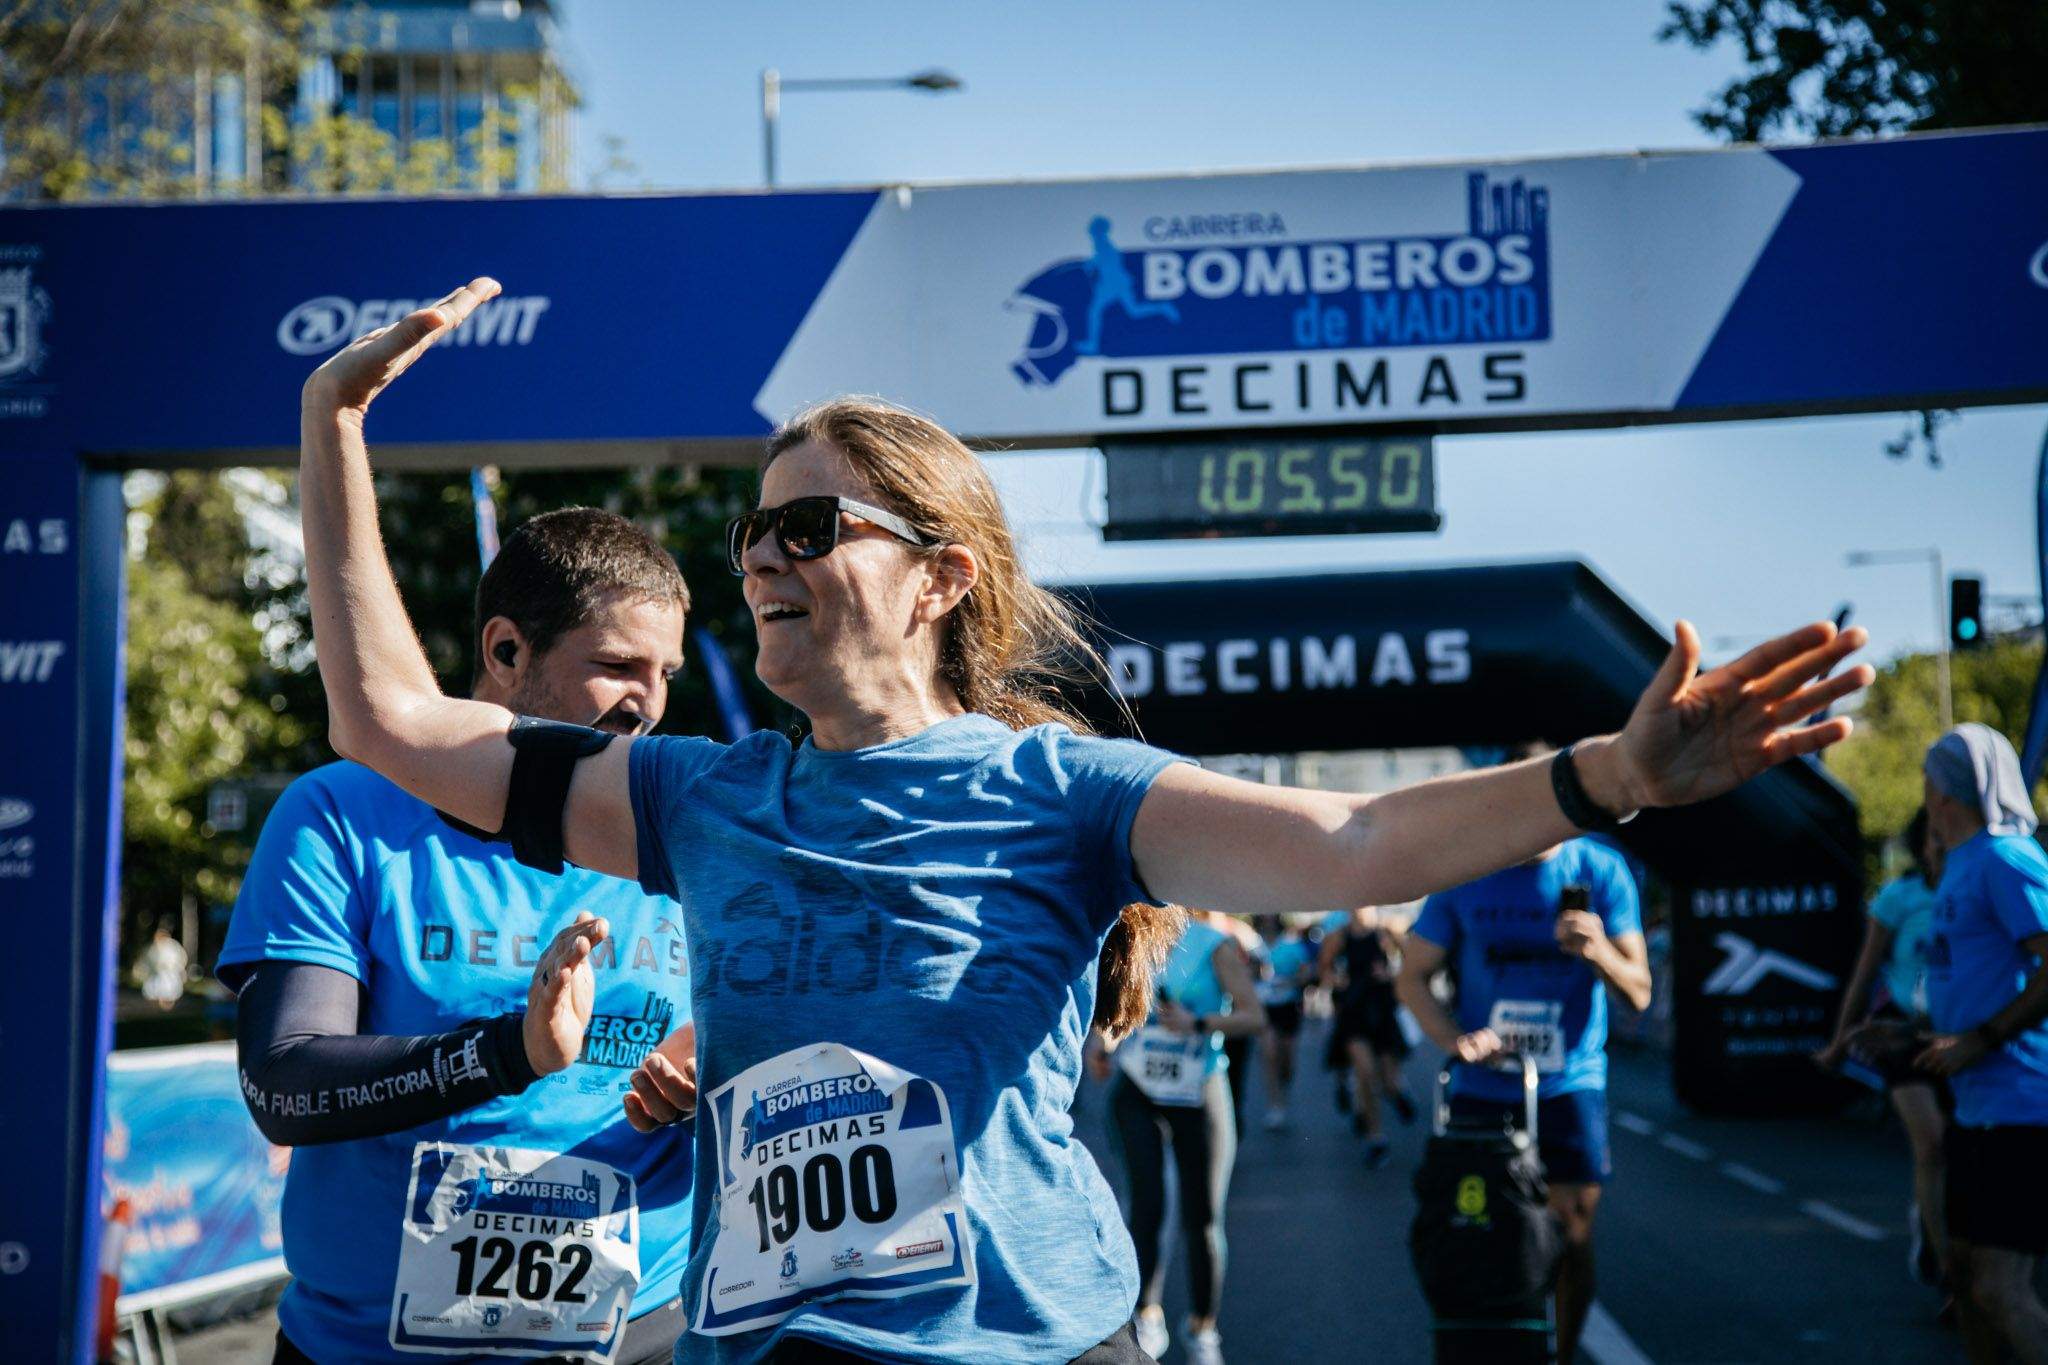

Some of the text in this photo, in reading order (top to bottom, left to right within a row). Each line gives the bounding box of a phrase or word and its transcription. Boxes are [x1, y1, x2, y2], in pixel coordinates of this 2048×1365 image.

[1144, 214, 1287, 241] CARRERA
[1144, 234, 1535, 300] BOMBEROS
[1294, 286, 1538, 347] de MADRID
[1103, 352, 1527, 417] DECIMAS
[1108, 628, 1473, 698] DECIMAS
[420, 925, 688, 977] DECMAS
[271, 1090, 330, 1117] FIABLE
[336, 1068, 433, 1110] TRACTORA
[765, 1075, 802, 1096] CARRERA
[766, 1074, 880, 1118] BOMBERO
[805, 1102, 823, 1123] de
[757, 1115, 886, 1166] DECIMAS
[492, 1180, 597, 1204] BOMBEROS
[748, 1144, 898, 1254] 1900
[474, 1213, 595, 1237] DECIMAS
[451, 1236, 594, 1304] 1262
